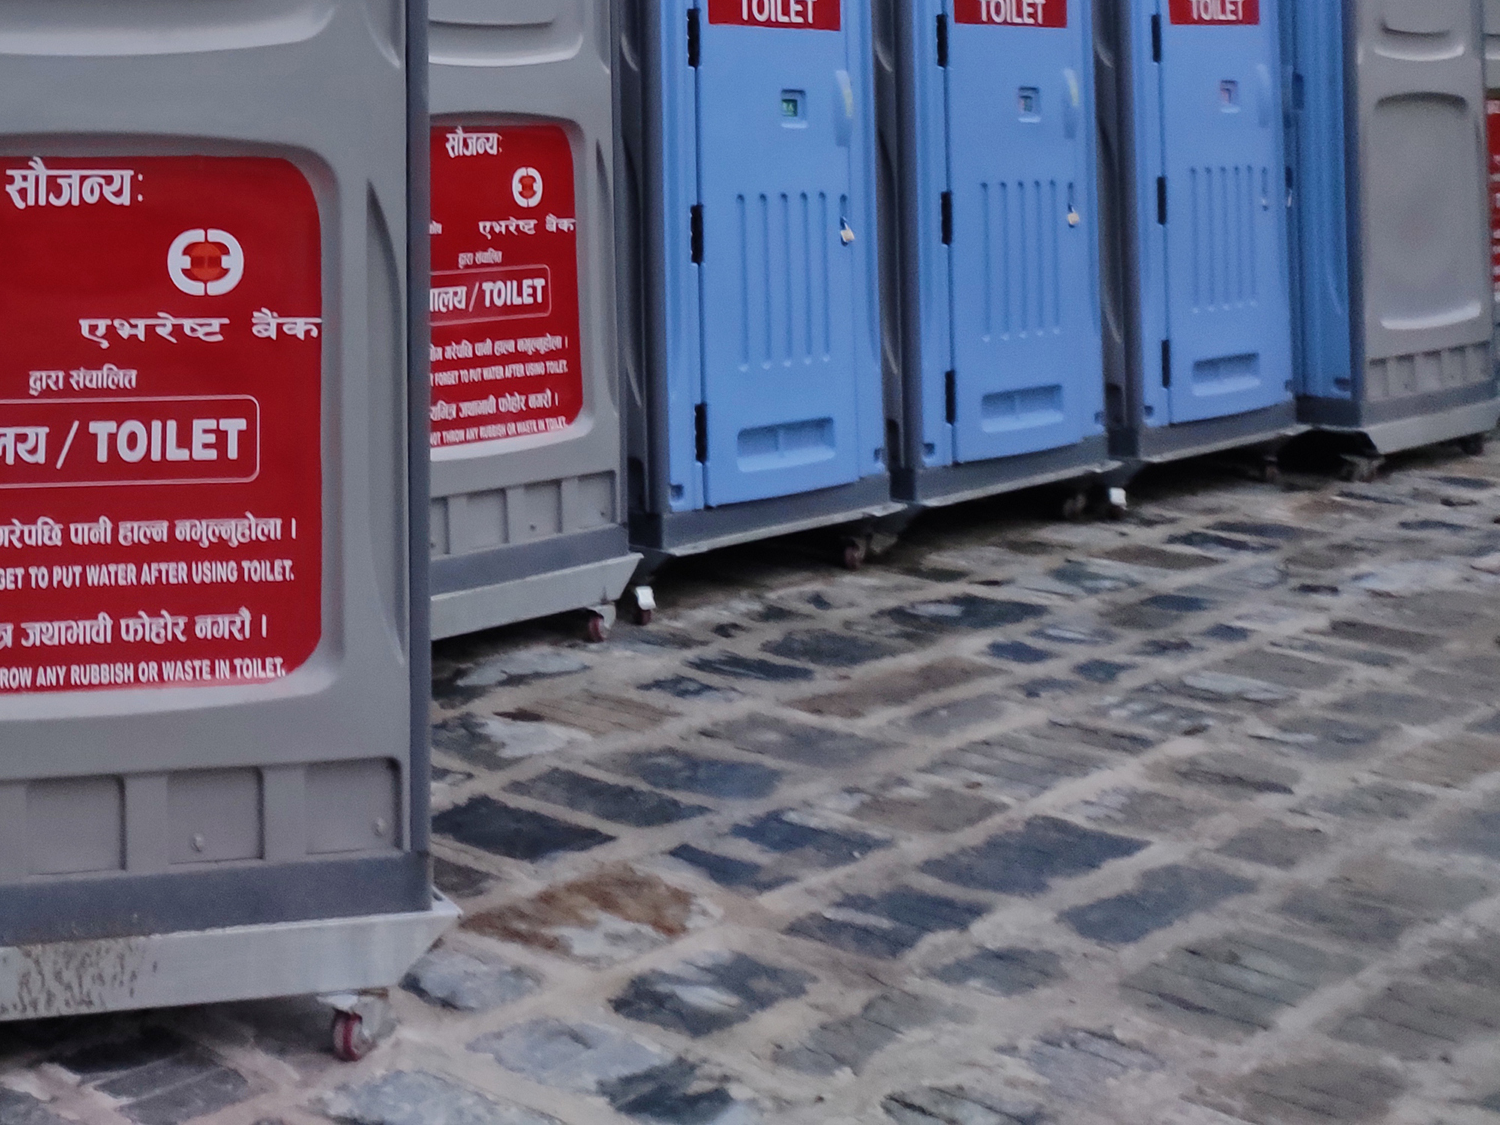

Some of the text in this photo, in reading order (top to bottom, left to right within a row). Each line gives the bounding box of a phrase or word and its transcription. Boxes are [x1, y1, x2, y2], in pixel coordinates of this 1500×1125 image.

[482, 277, 546, 308] TOILET
[78, 306, 323, 350] एभरेष्ट बैंक
[55, 420, 80, 470] /
[88, 418, 247, 463] TOILET
[69, 515, 113, 546] पानी
[118, 520, 170, 546] हाल्न
[28, 566, 49, 589] TO
[52, 565, 83, 588] PUT
[86, 562, 137, 587] WATER
[140, 561, 189, 586] AFTER
[191, 559, 239, 584] USING
[241, 559, 295, 583] TOILET.
[120, 609, 189, 644] फोहोर
[35, 665, 67, 687] ANY
[70, 662, 135, 686] RUBBISH
[138, 661, 159, 683] OR
[161, 659, 211, 682] WASTE
[214, 658, 230, 679] IN
[233, 656, 286, 679] TOILET.
